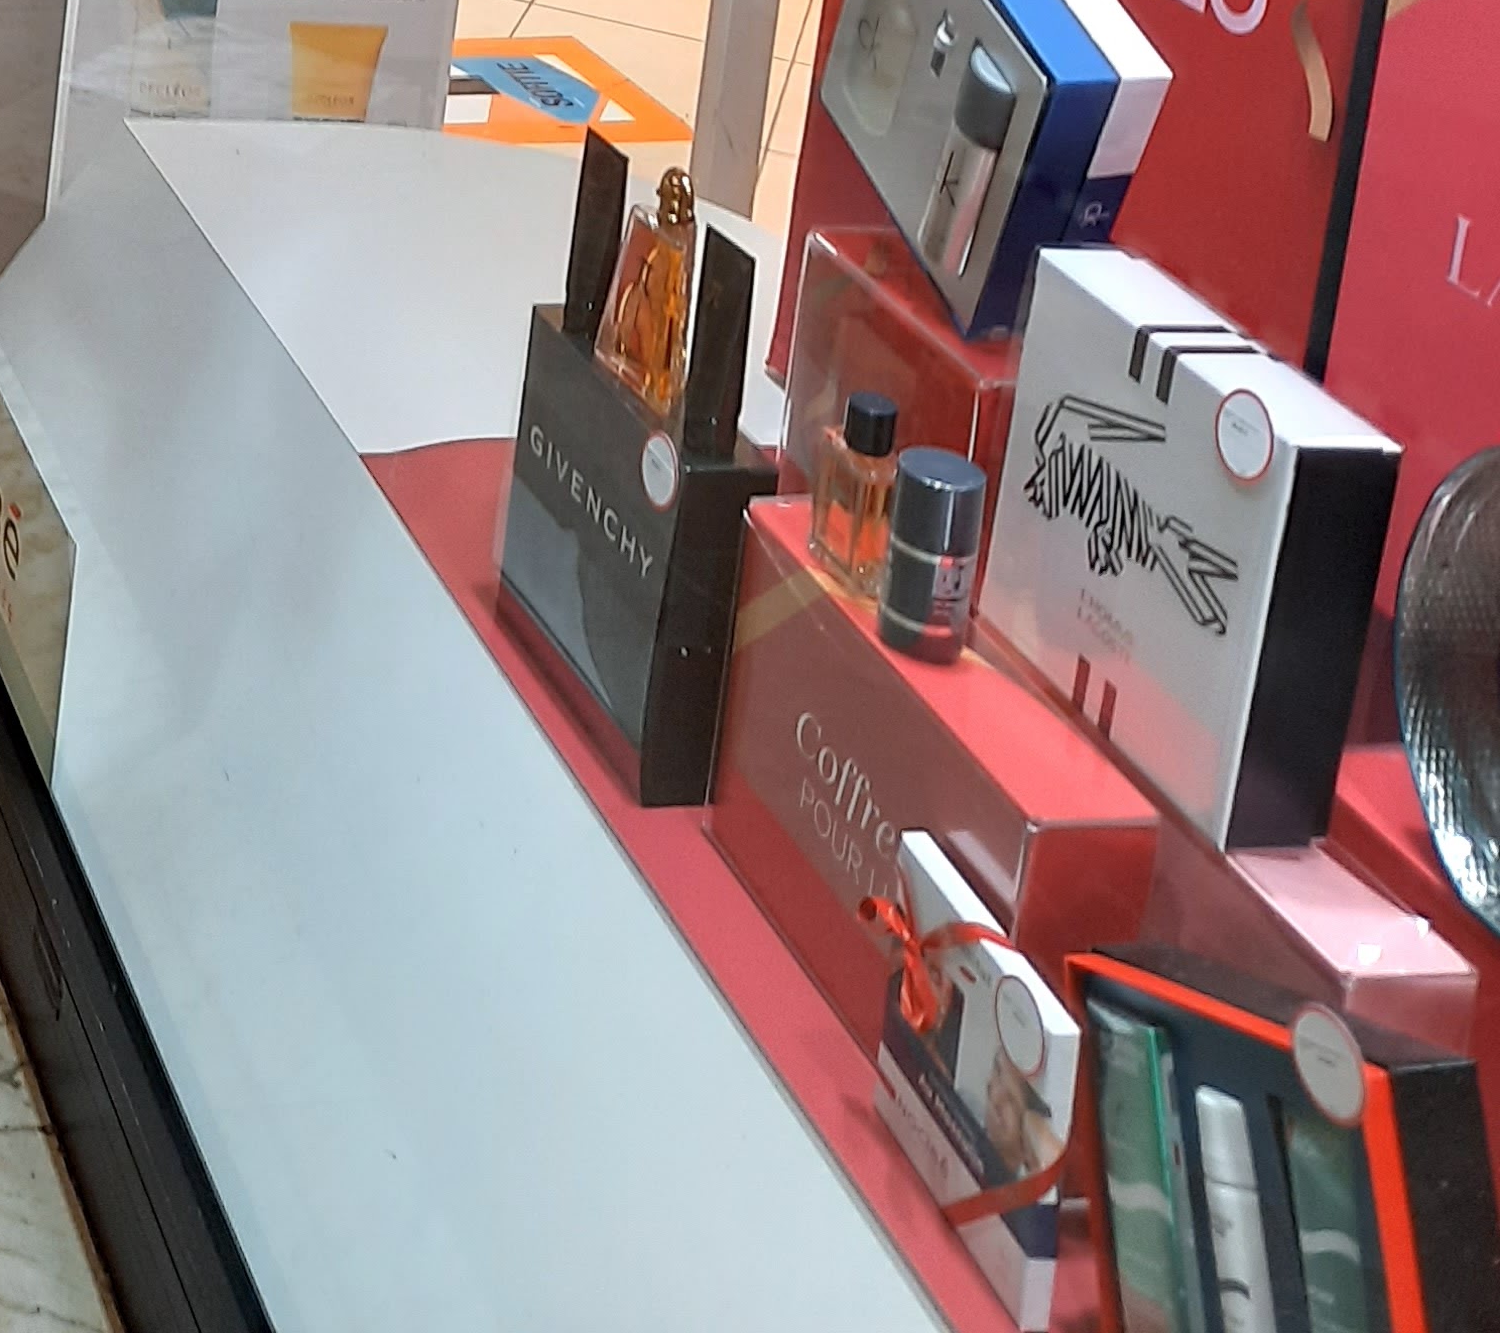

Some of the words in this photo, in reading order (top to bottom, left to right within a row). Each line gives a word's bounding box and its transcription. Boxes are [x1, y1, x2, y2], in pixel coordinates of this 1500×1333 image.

[530, 425, 653, 579] GIVENCHY
[796, 712, 897, 860] Coffre
[800, 778, 864, 886] POUR
